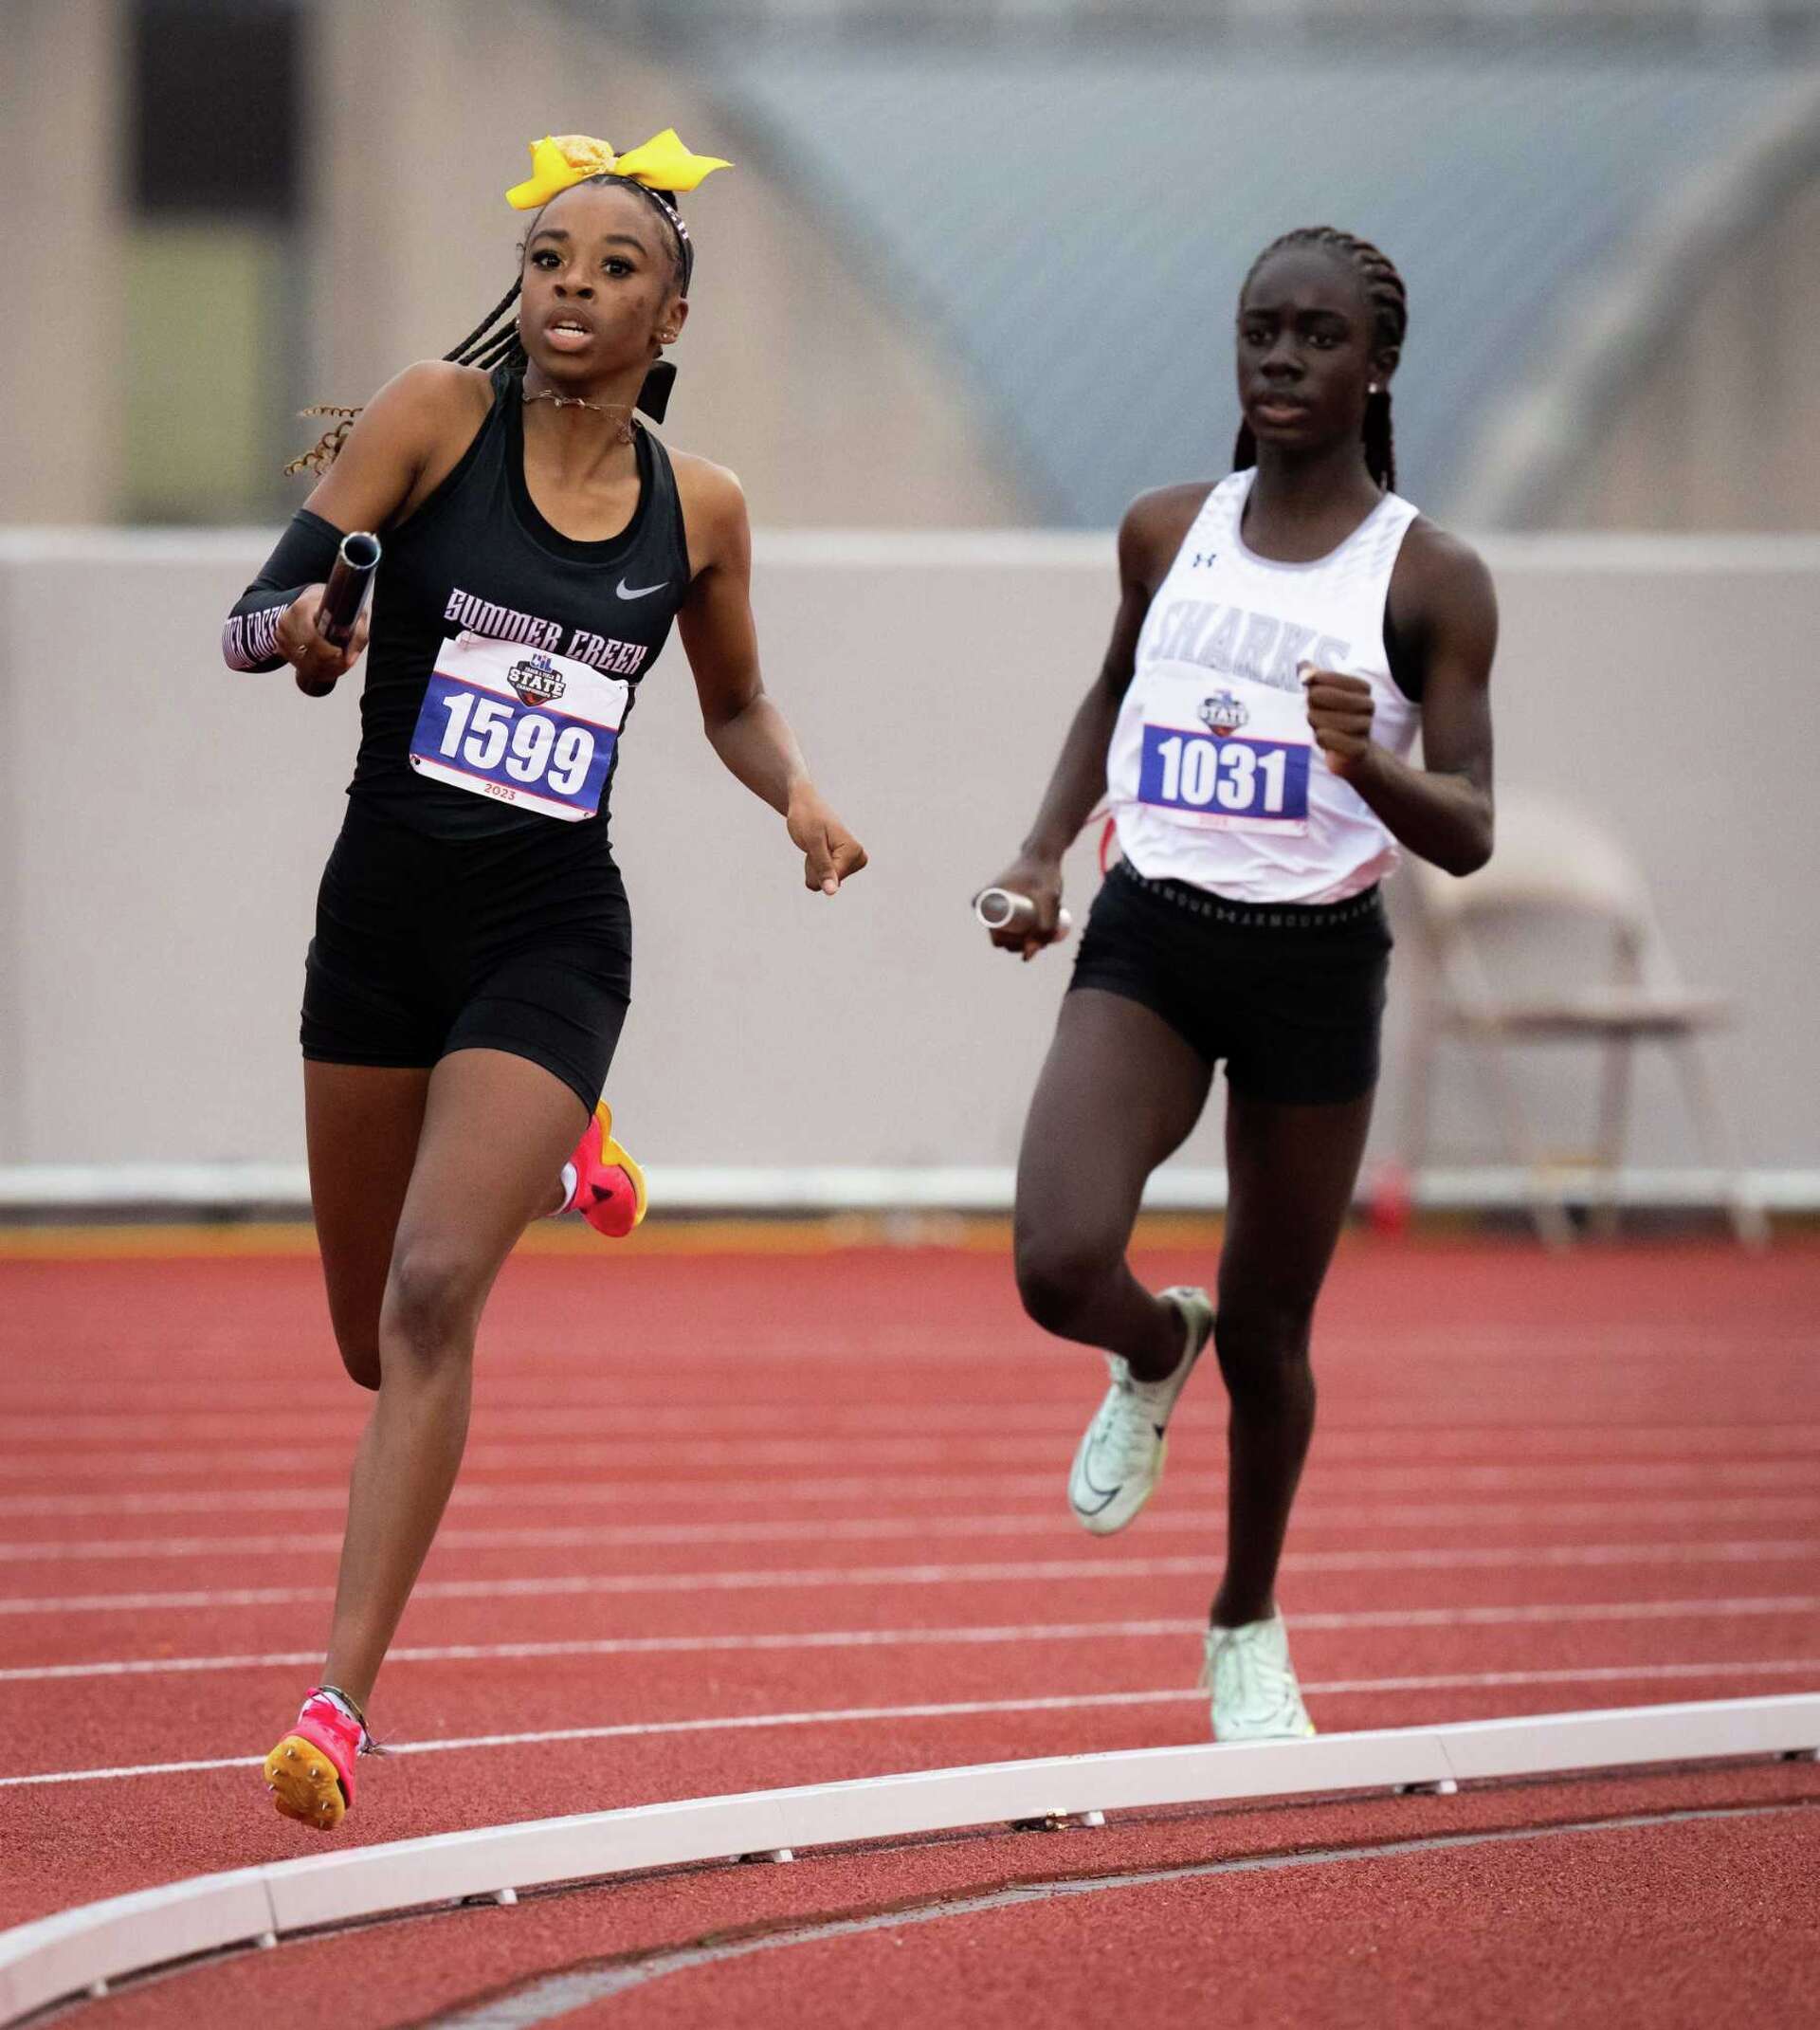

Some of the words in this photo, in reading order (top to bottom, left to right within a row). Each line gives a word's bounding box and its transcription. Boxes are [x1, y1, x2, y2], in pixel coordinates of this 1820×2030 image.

[444, 588, 563, 653] SUMMER
[565, 630, 648, 675] CREEK
[509, 668, 565, 697] STATE
[440, 692, 595, 795] 1599
[1157, 736, 1287, 812] 1031
[483, 783, 517, 801] 2023
